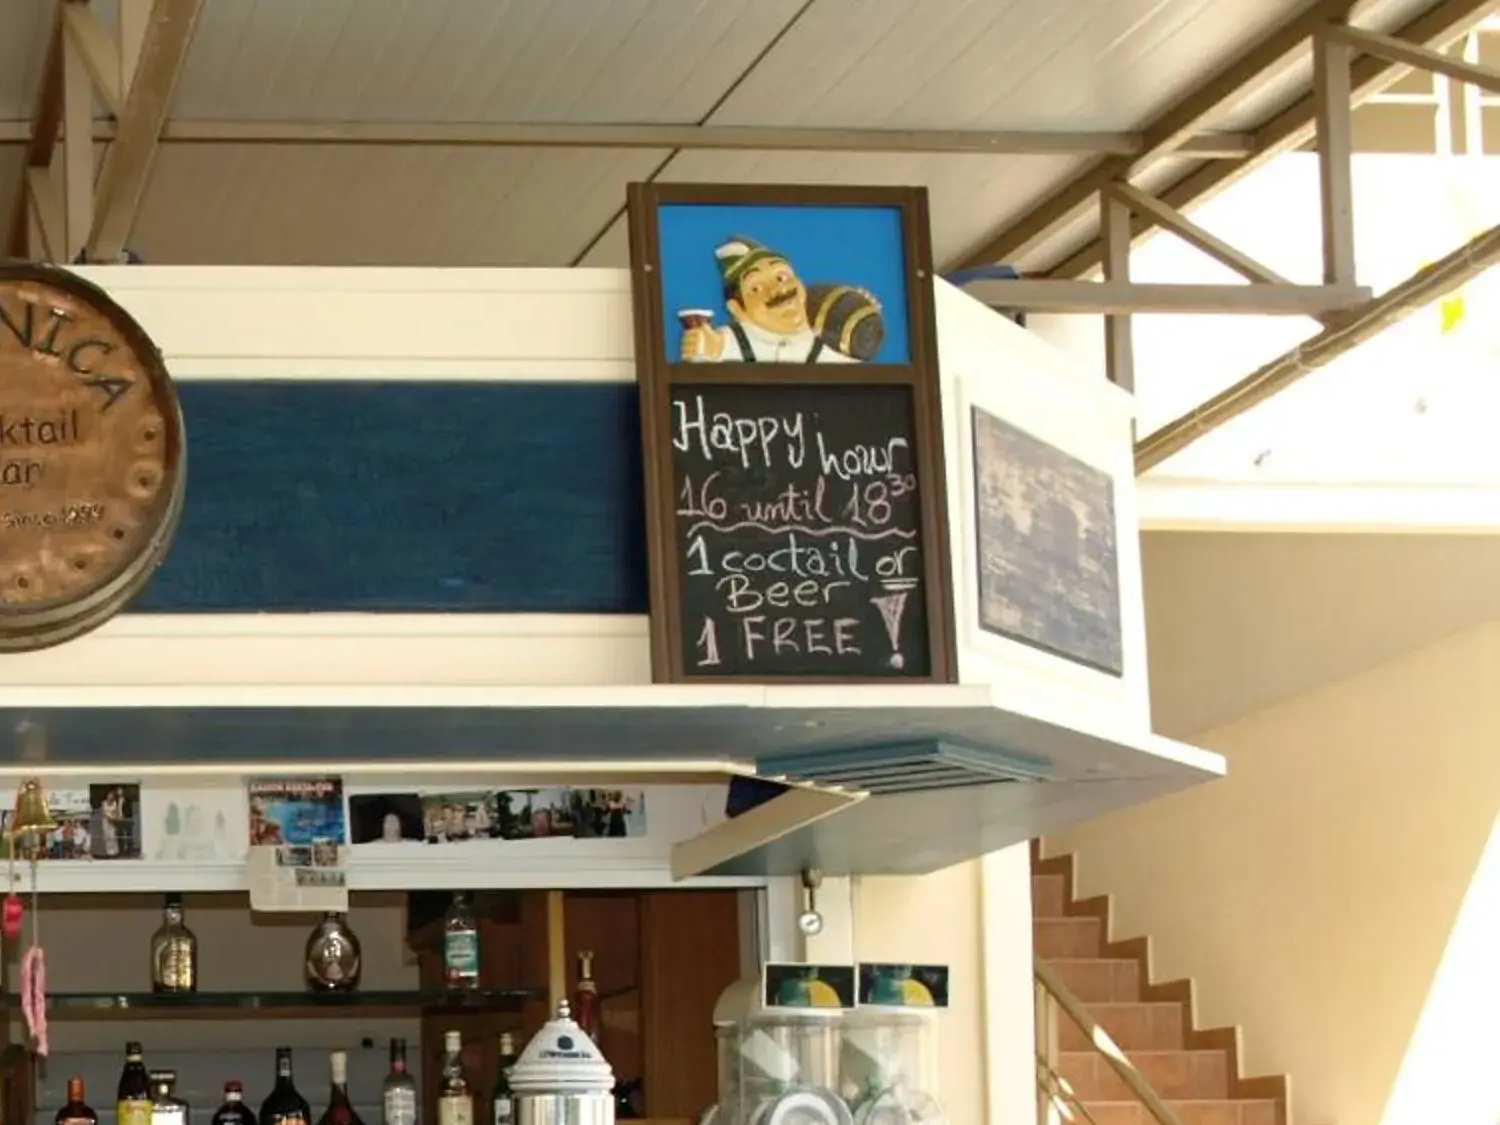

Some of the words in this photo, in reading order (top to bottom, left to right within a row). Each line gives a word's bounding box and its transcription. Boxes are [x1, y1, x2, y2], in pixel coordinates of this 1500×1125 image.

[673, 396, 804, 469] Happy
[817, 432, 907, 480] hour
[676, 471, 727, 519] 16
[741, 475, 833, 524] until
[875, 546, 917, 576] or
[716, 574, 853, 612] Beer
[697, 617, 721, 666] 1
